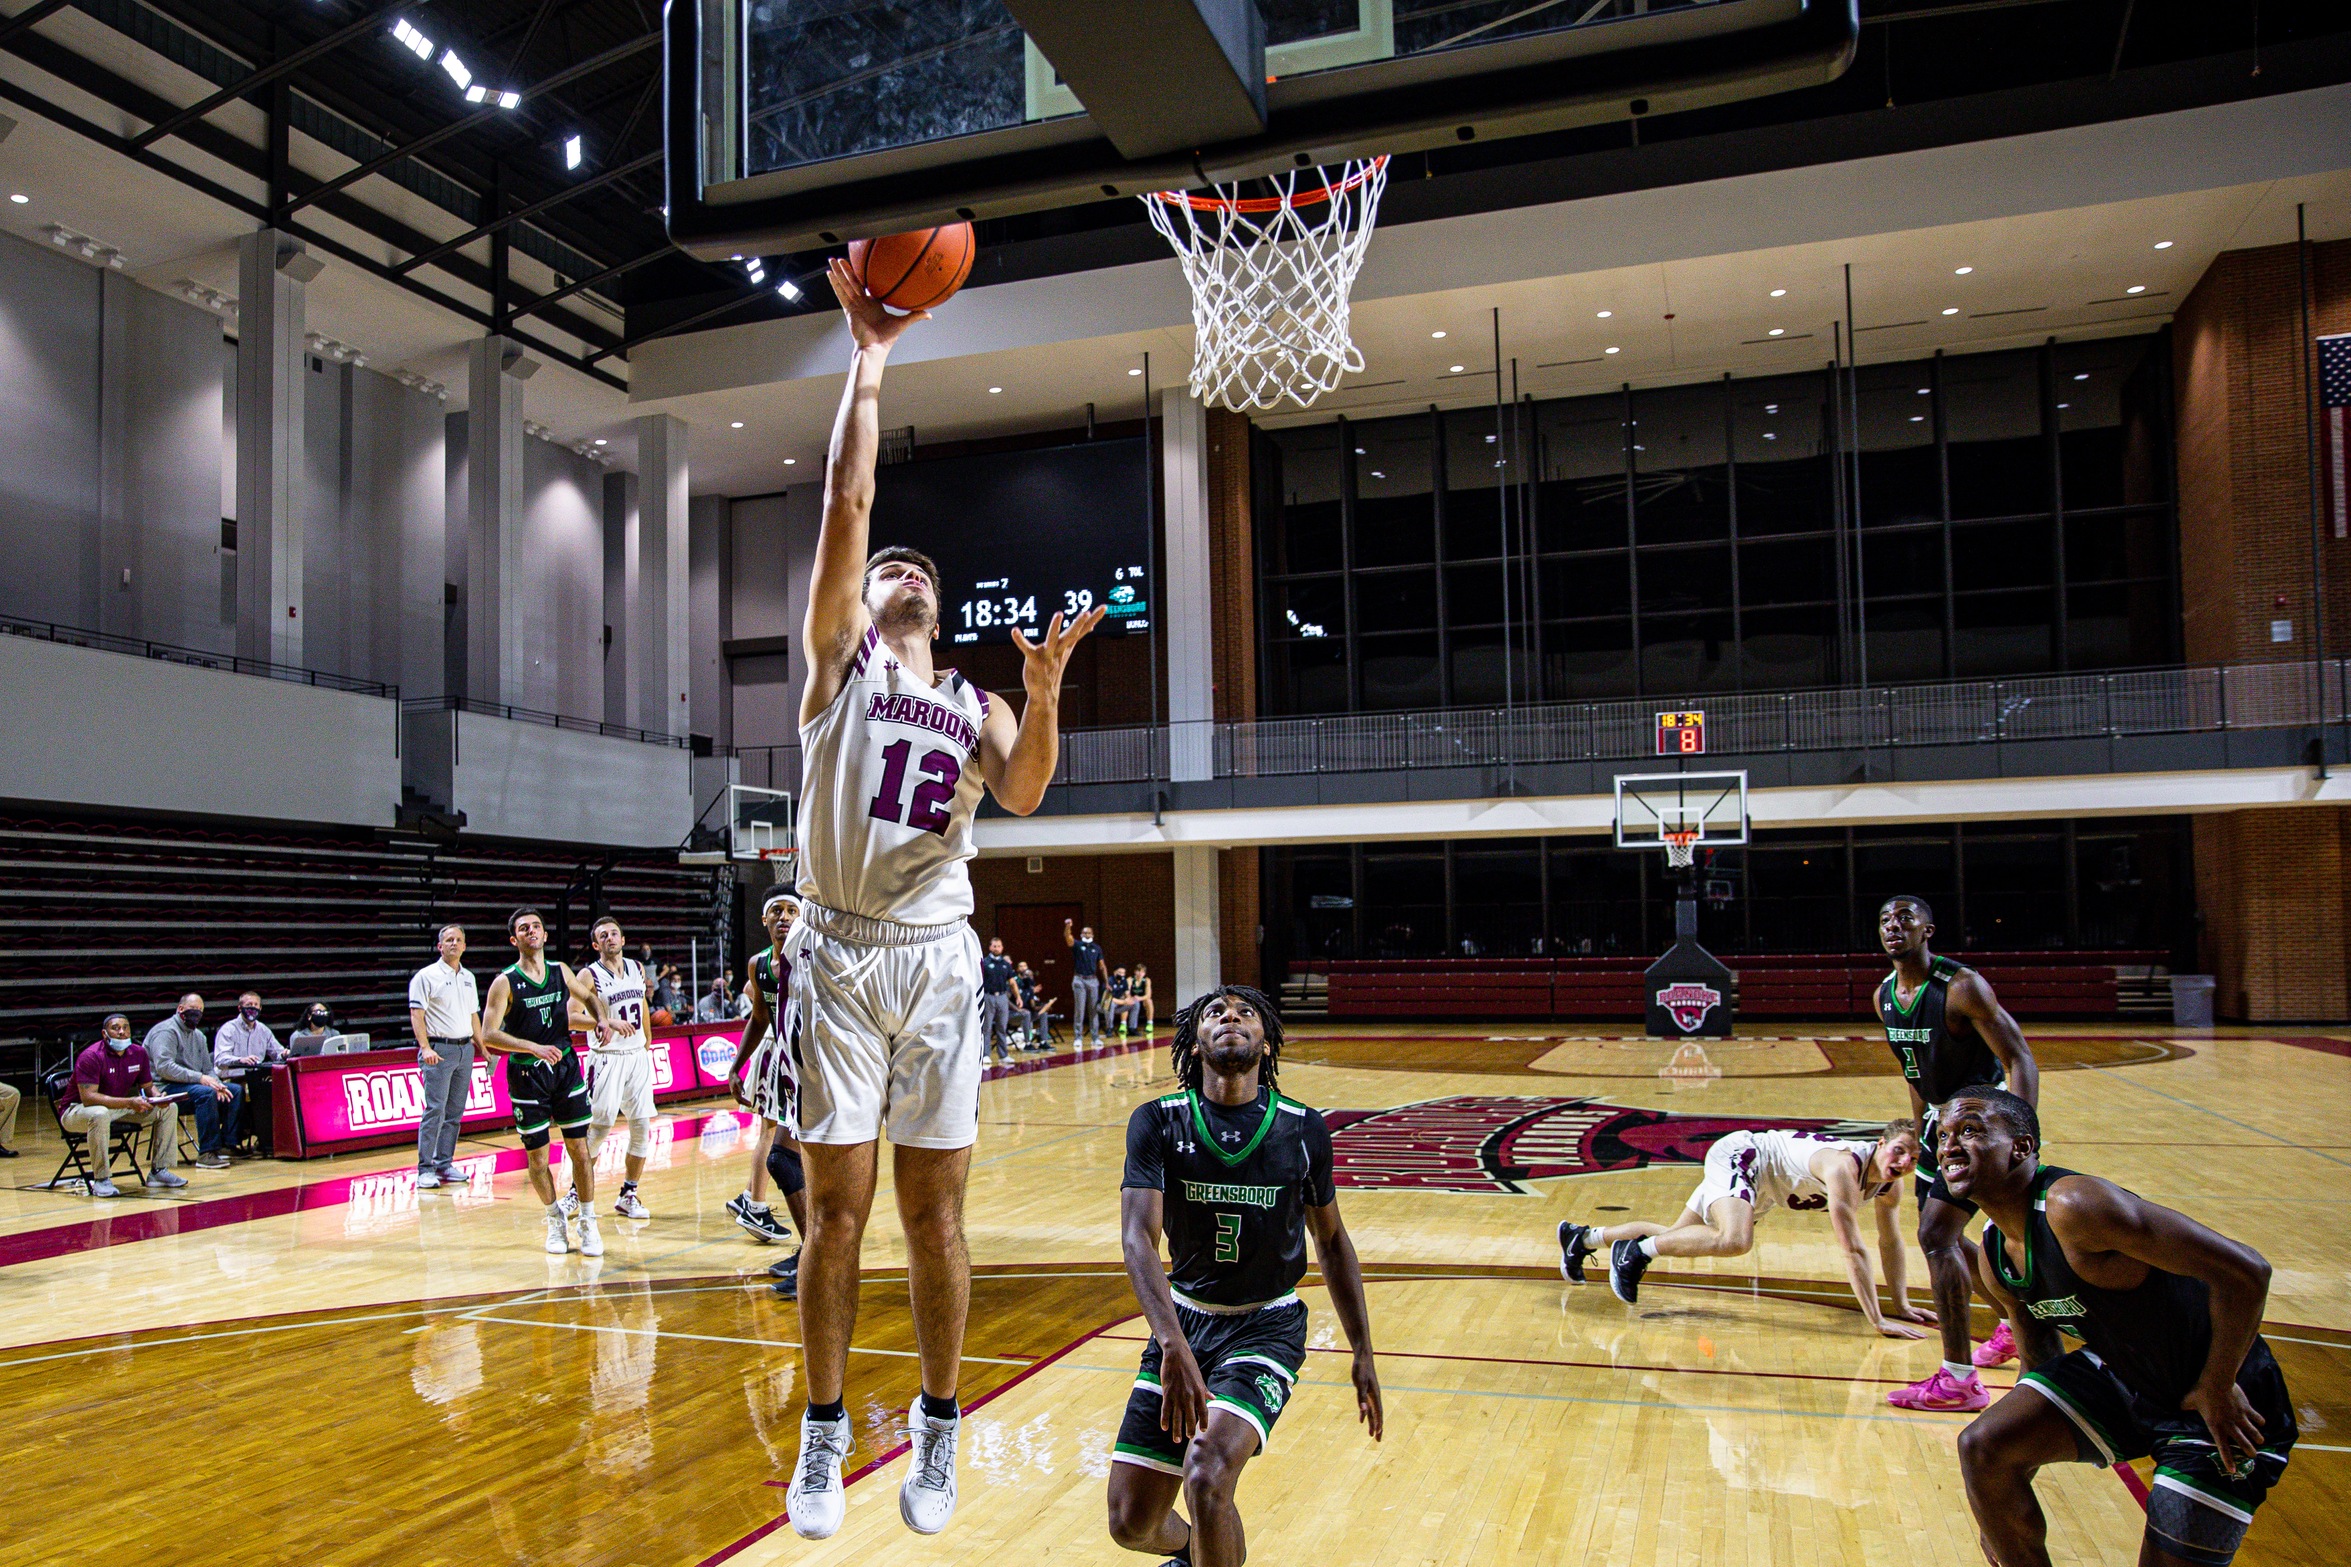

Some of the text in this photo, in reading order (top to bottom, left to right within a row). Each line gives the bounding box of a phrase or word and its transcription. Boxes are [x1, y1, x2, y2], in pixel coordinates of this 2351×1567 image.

[960, 595, 1038, 629] 18:34
[1063, 589, 1093, 616] 39
[1661, 712, 1704, 728] 18:34
[1680, 729, 1697, 753] 8
[868, 737, 961, 838] 12
[607, 988, 645, 1006] MAROONS
[617, 1002, 642, 1031] 13
[700, 1045, 737, 1067] ODAC
[1901, 1047, 1921, 1079] 2
[343, 1062, 496, 1130] ROANE
[1180, 1179, 1286, 1211] GREENSBORO
[1214, 1212, 1242, 1264] 3
